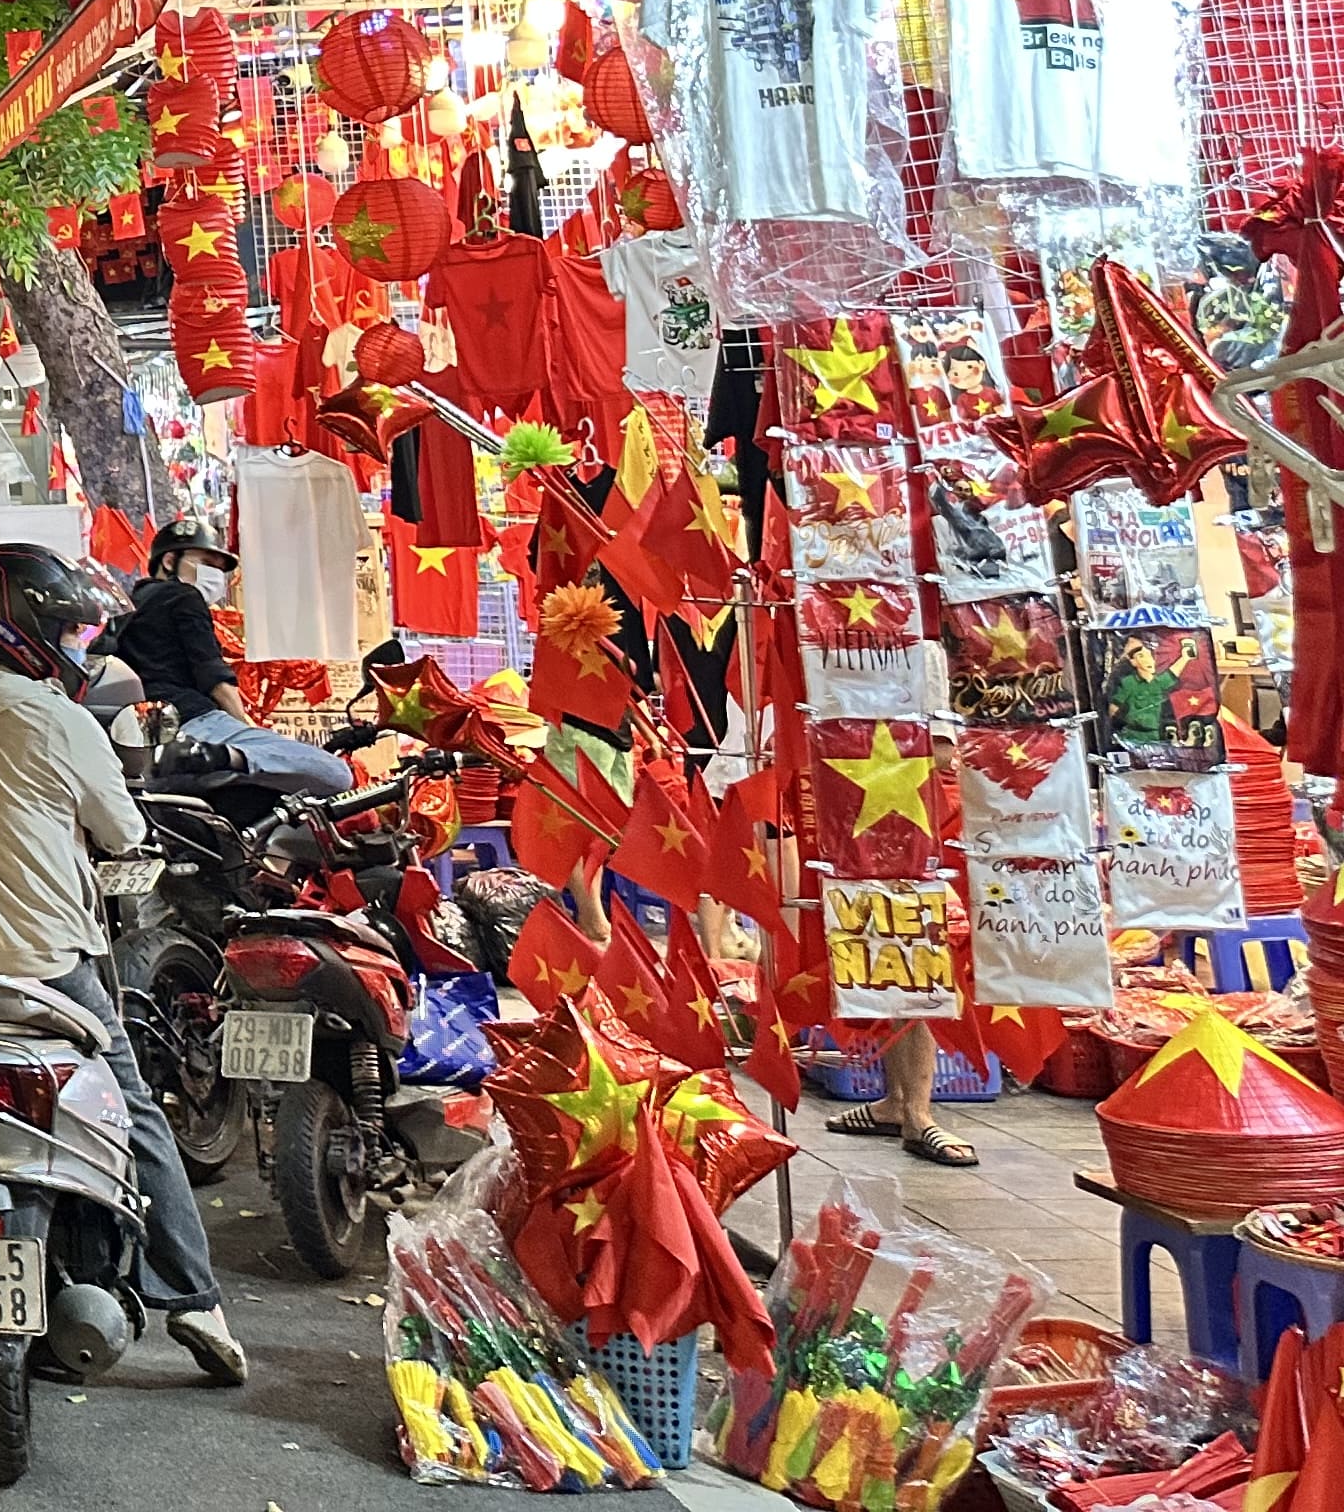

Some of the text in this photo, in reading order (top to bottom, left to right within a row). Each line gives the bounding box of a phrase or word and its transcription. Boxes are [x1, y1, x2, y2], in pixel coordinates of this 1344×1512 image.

[1022, 29, 1103, 52] Breakng
[1181, 827, 1209, 849] do
[1045, 882, 1075, 904] do
[831, 941, 955, 993] NAM
